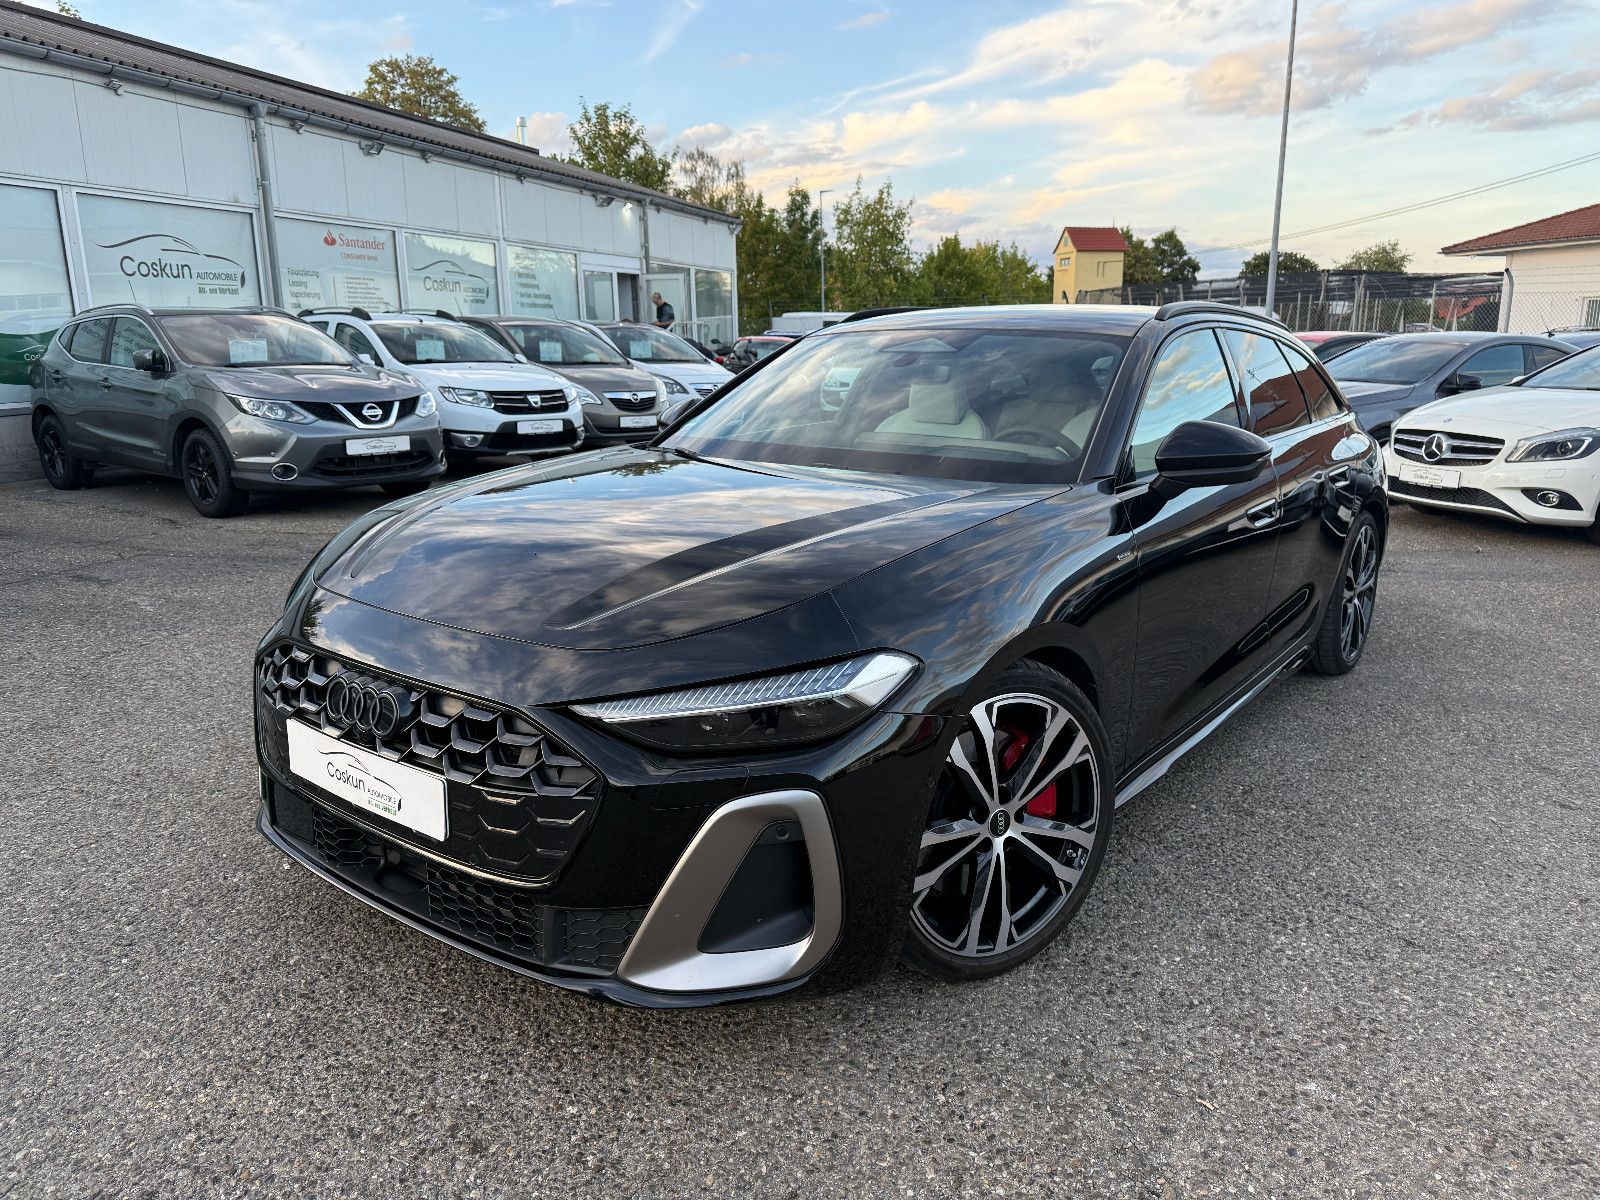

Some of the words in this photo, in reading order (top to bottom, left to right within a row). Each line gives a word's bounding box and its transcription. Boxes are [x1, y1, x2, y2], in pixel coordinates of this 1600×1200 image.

[338, 233, 385, 250] Santander
[120, 255, 193, 279] Coskun
[196, 271, 238, 281] AUTOMOBILE
[423, 276, 461, 292] Coskun
[326, 761, 366, 792] Coskun
